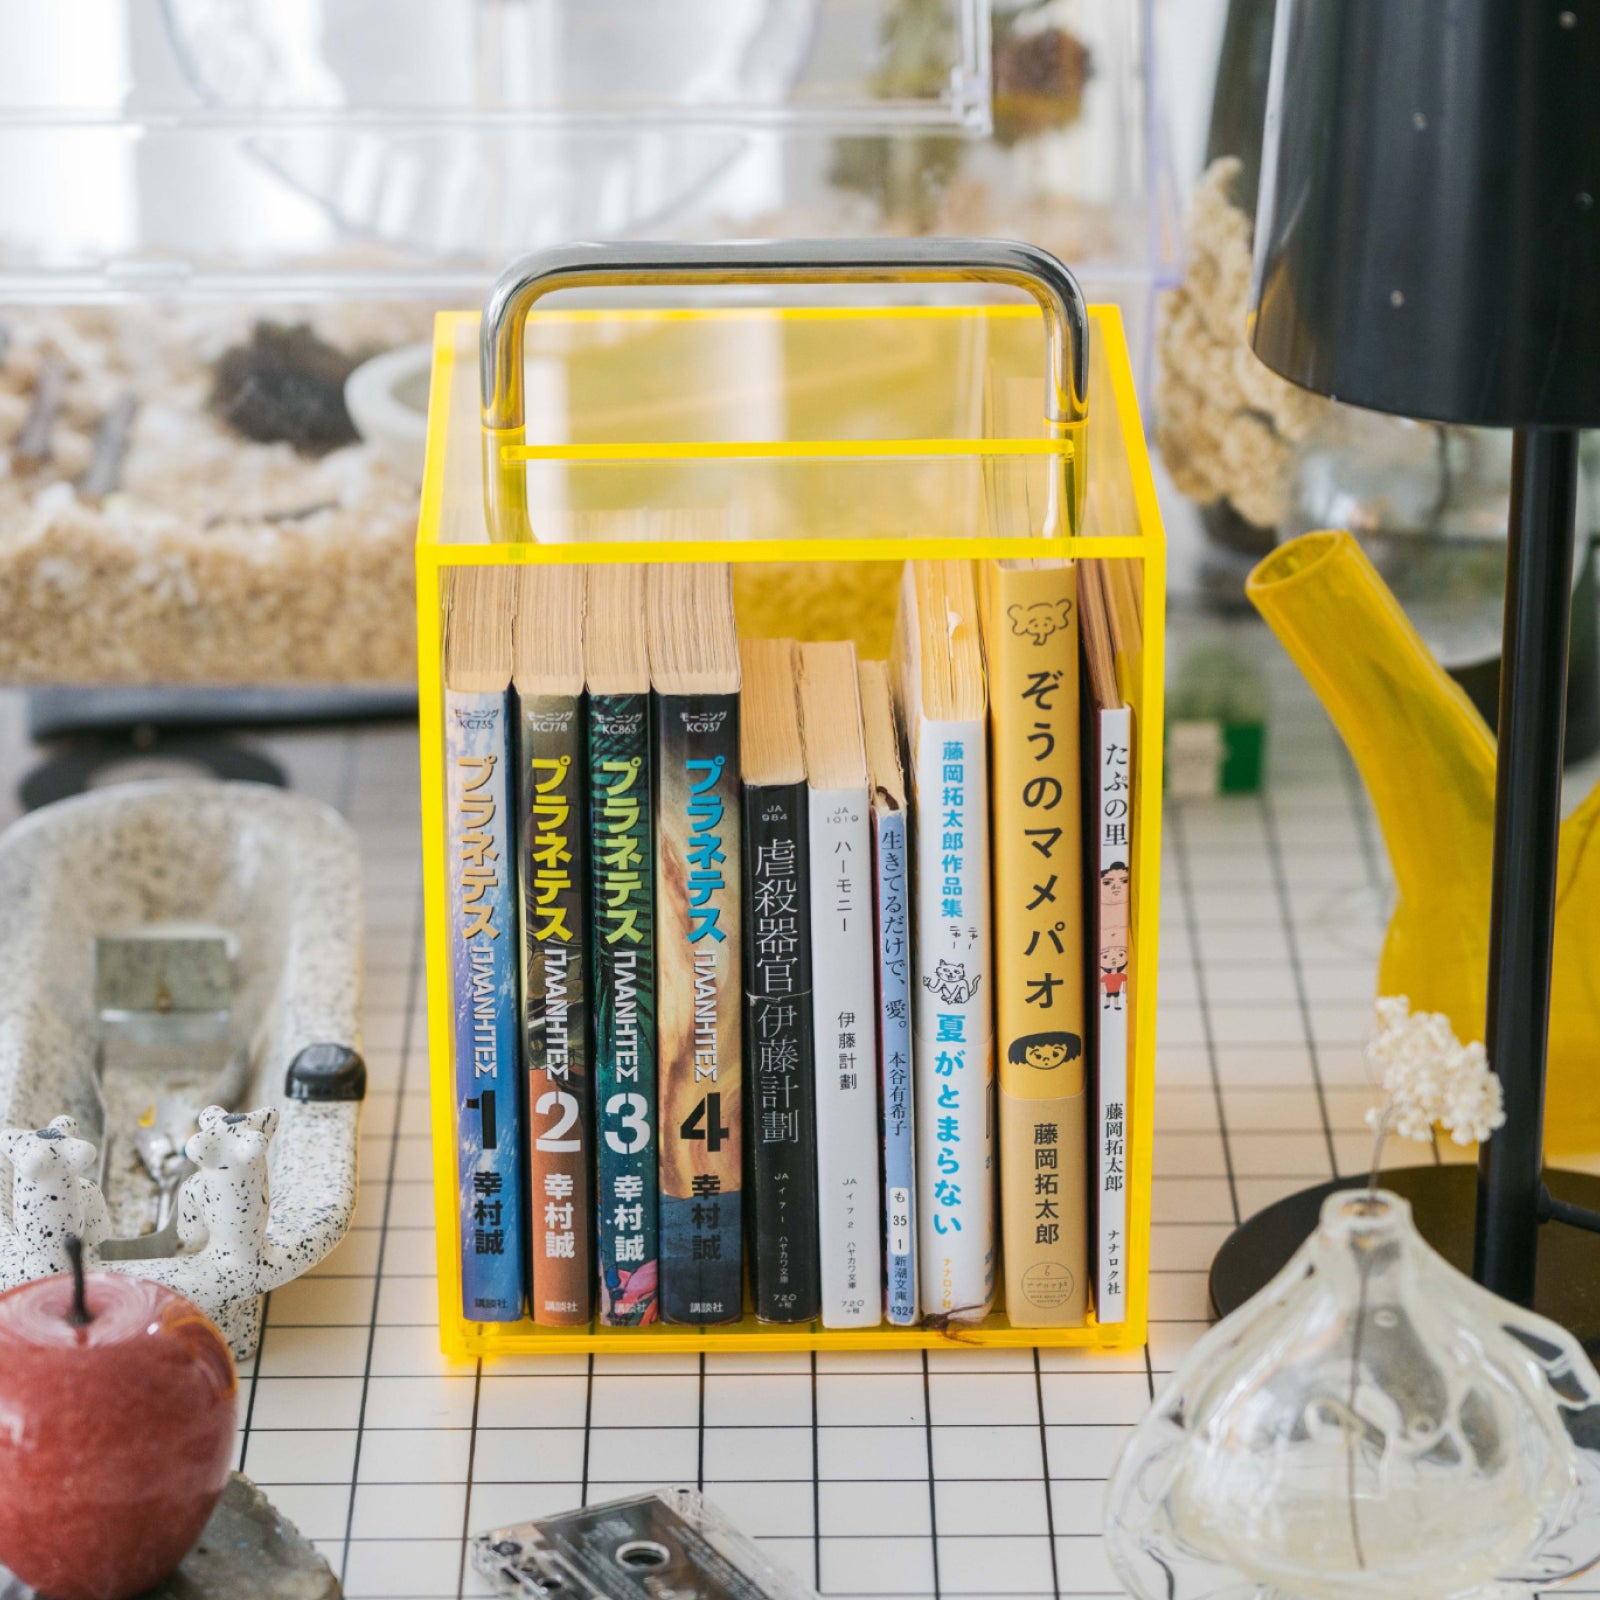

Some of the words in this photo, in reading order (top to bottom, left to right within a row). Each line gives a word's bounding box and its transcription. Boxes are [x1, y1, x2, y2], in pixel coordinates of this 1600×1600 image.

[454, 708, 500, 719] モーニング
[459, 719, 494, 730] KC735
[527, 711, 574, 721] モーニング
[532, 721, 568, 732] KC778
[596, 711, 643, 723] モーニング
[602, 723, 637, 735] KC863
[680, 710, 728, 722] モーニング
[685, 721, 721, 732] KC937
[761, 813, 788, 822] 984
[767, 805, 783, 813] JA
[826, 816, 859, 824] 1019
[834, 807, 849, 815] JA
[1103, 743, 1129, 847] たぷの里
[457, 753, 500, 941] プラネテス
[531, 754, 574, 942] プラネテス
[602, 756, 644, 945] プラネテス
[684, 755, 727, 944] プラネテス
[941, 741, 964, 919] 藤岡拓太郎作品集
[1021, 669, 1066, 1009] ぞうのマメパオ
[754, 838, 799, 993] 虐殺器官
[834, 841, 853, 932] ハーモニー
[757, 1003, 800, 1144] 伊藤計劃
[837, 1011, 858, 1091] 伊藤計劃
[467, 1089, 497, 1150] 1
[535, 1091, 581, 1152] 2
[604, 1092, 651, 1154] 3
[680, 1092, 729, 1153] 4
[888, 1051, 908, 1136] 本谷有希子
[933, 1013, 967, 1235] 夏がとまらない
[1104, 1103, 1123, 1192] 藤岡拓太郎
[472, 1172, 504, 1255] 幸村誠
[894, 1191, 905, 1203] も
[1033, 1123, 1060, 1245] 藤岡拓太郎
[544, 1173, 575, 1259] 幸村誠
[614, 1175, 645, 1262] 幸村誠
[690, 1174, 721, 1262] 幸村誠
[893, 1215, 907, 1227] 35
[1107, 1230, 1121, 1296] ナナロク社
[544, 1300, 578, 1313] 講談社
[614, 1302, 648, 1314] 講談社
[690, 1301, 724, 1314] 講談社
